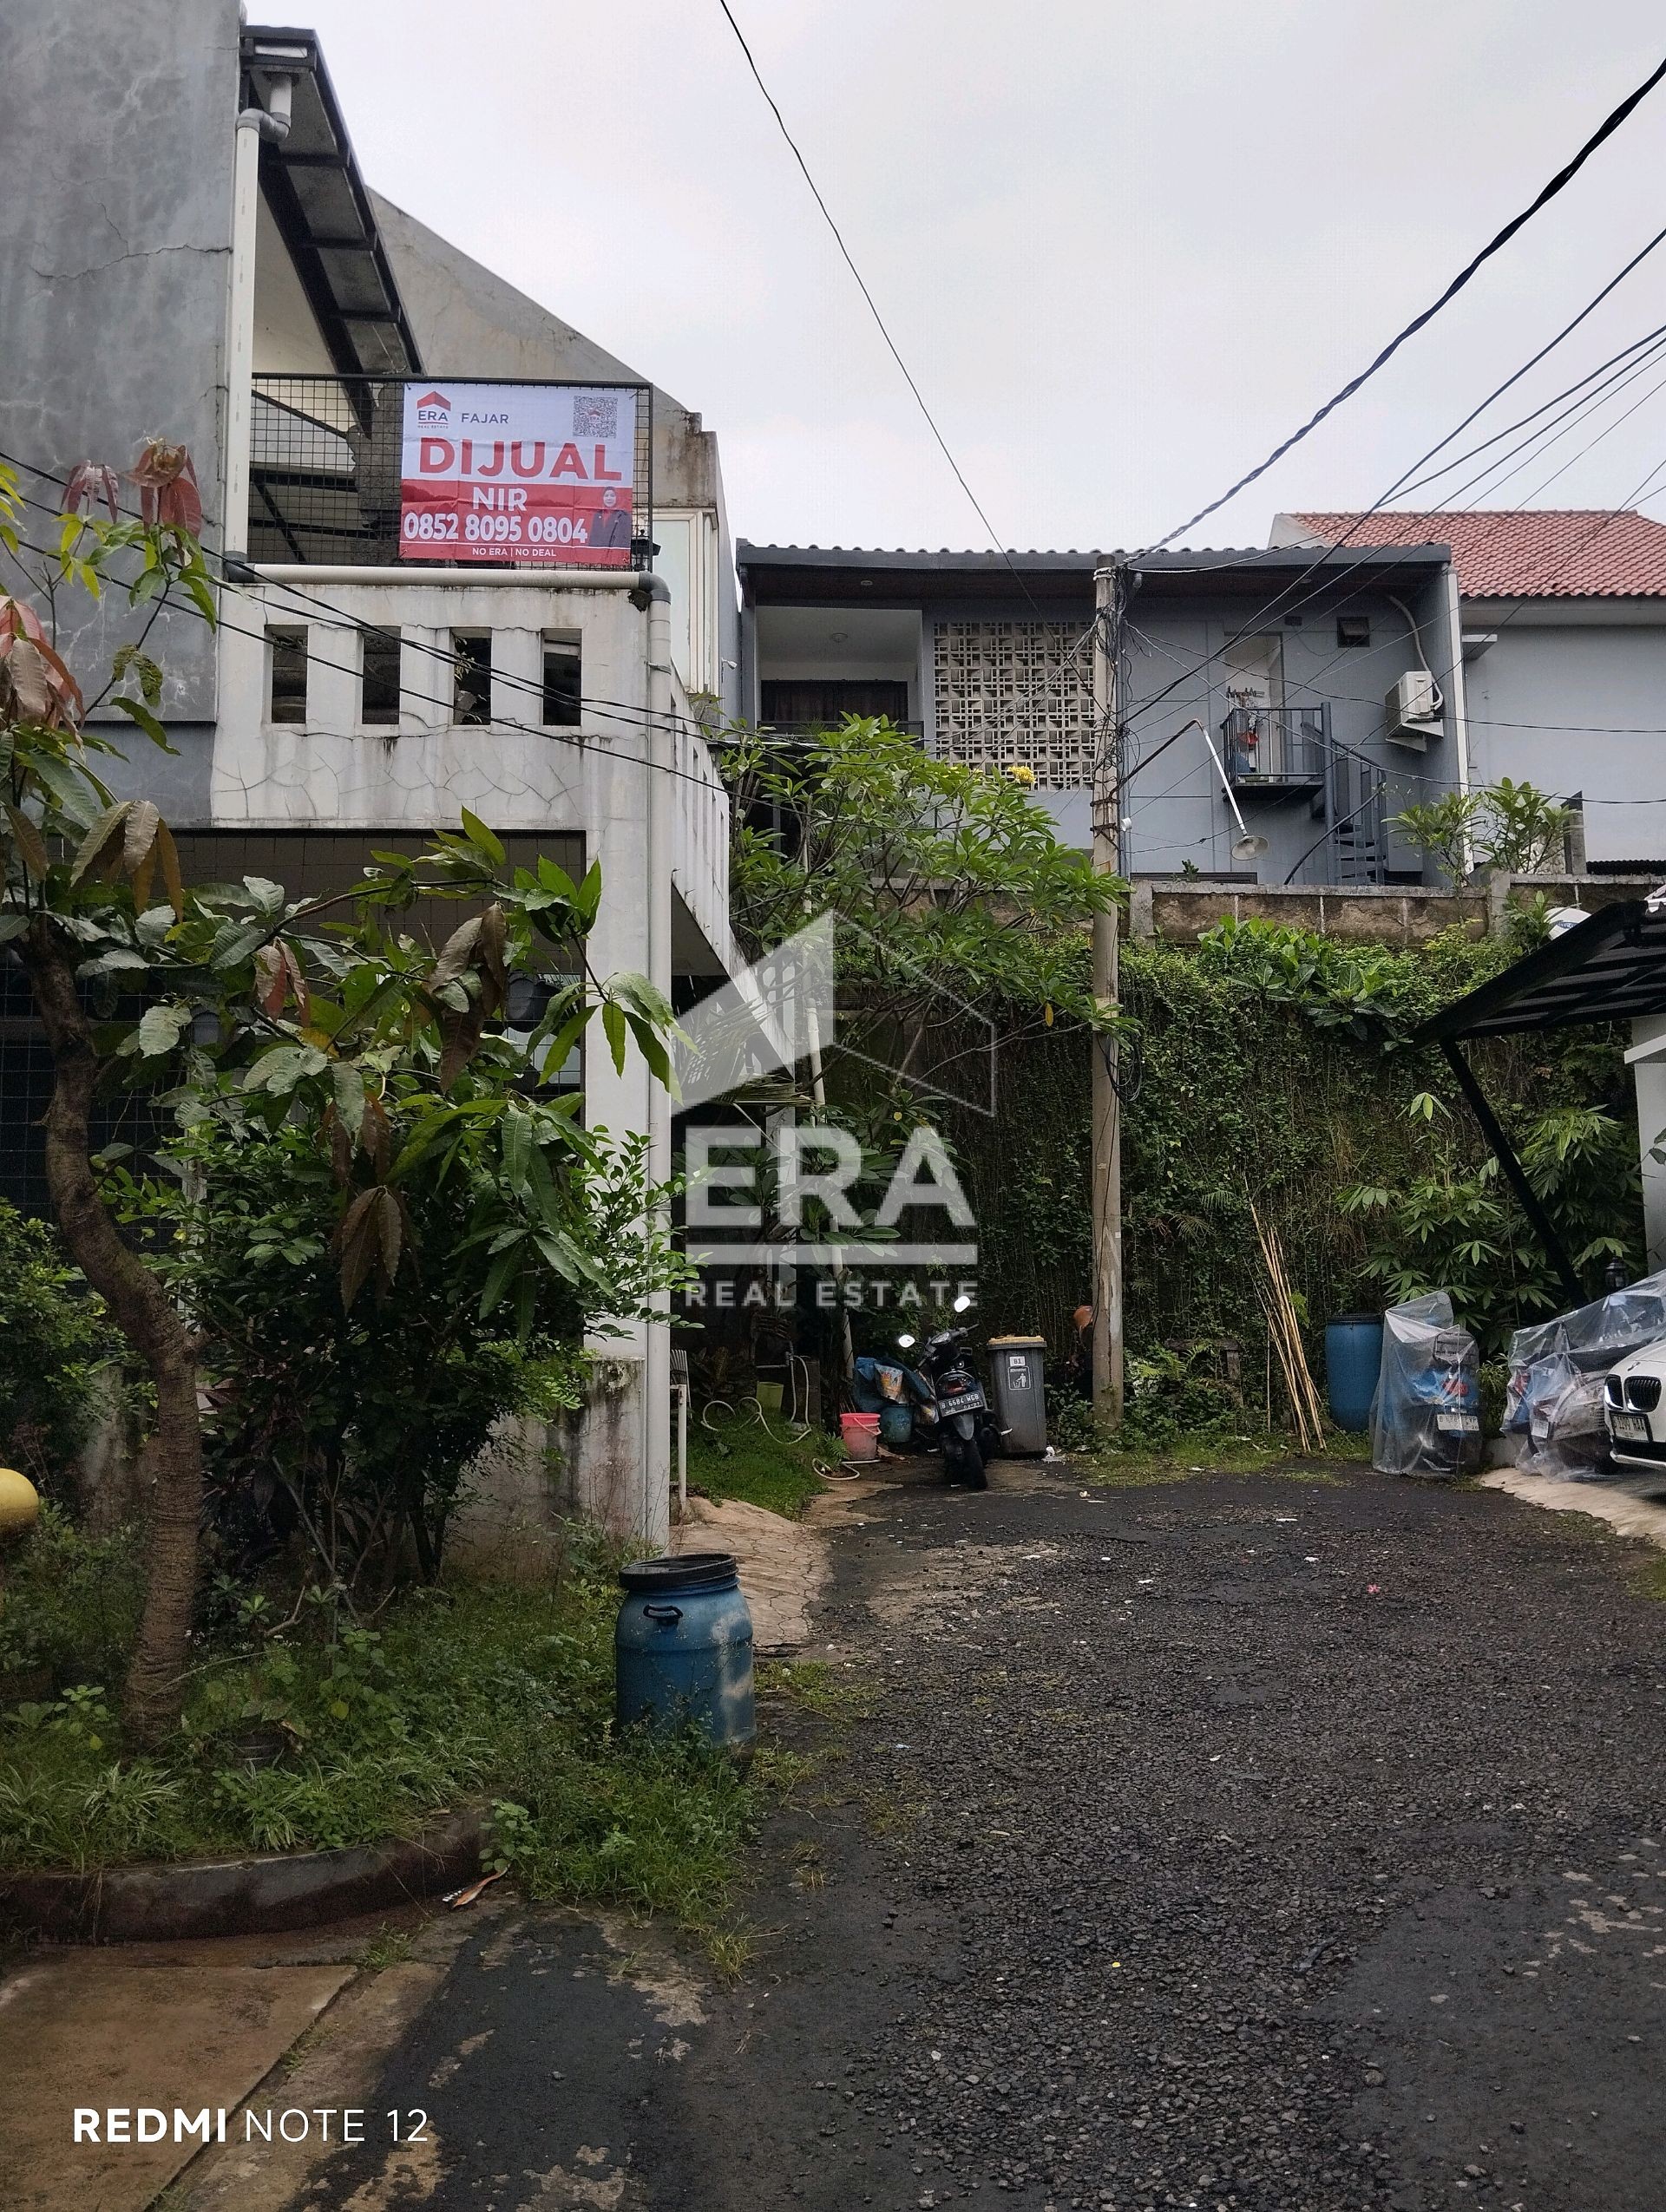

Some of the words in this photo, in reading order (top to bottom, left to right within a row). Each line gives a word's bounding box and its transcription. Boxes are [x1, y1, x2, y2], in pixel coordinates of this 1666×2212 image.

[417, 410, 449, 422] ERA
[461, 413, 509, 424] FAJAR
[419, 436, 622, 481] DIJUAL
[473, 487, 528, 512] NIR
[403, 512, 459, 540] 0852
[464, 514, 521, 542] 8095
[528, 516, 588, 544] 0804
[532, 548, 556, 557] DEAL
